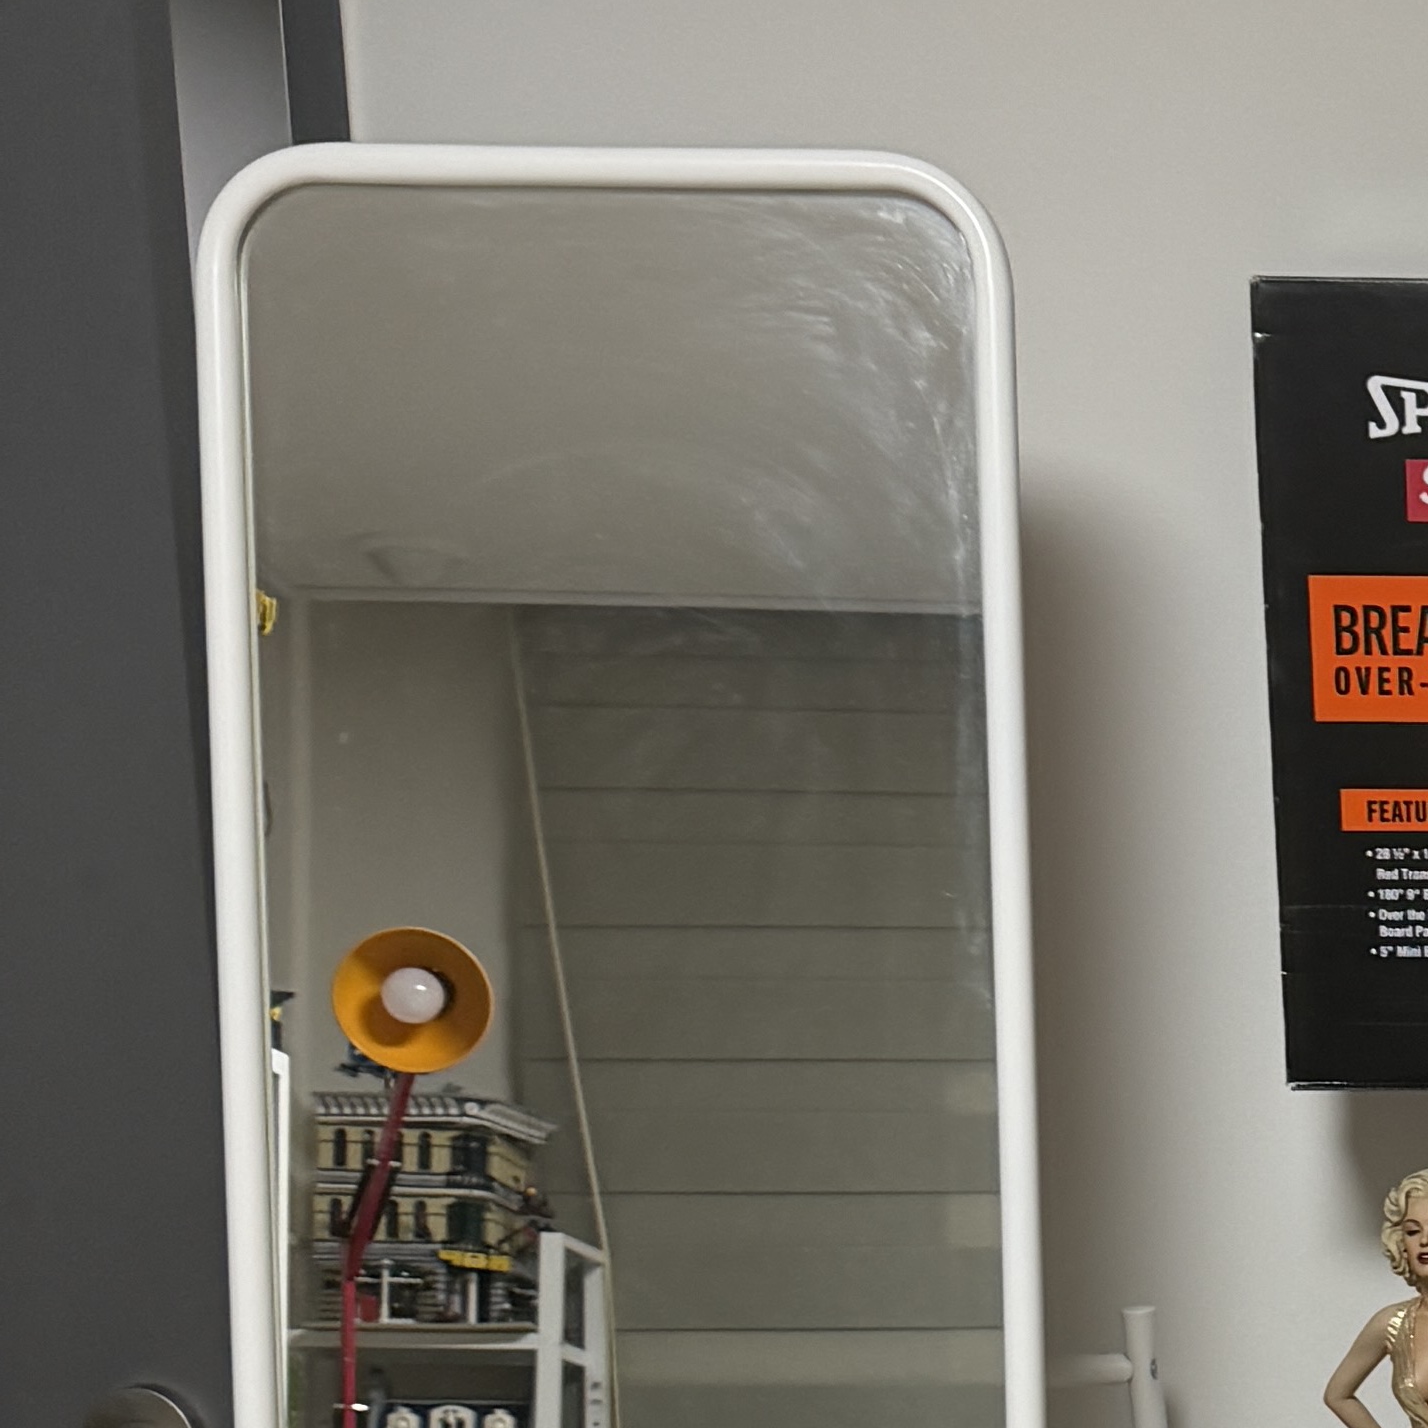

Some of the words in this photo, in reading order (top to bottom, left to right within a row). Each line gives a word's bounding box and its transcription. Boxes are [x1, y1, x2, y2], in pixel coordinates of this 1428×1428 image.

[1378, 909, 1404, 920] Over
[1407, 909, 1425, 920] the
[1379, 925, 1413, 937] Board
[1396, 945, 1421, 957] Mini
